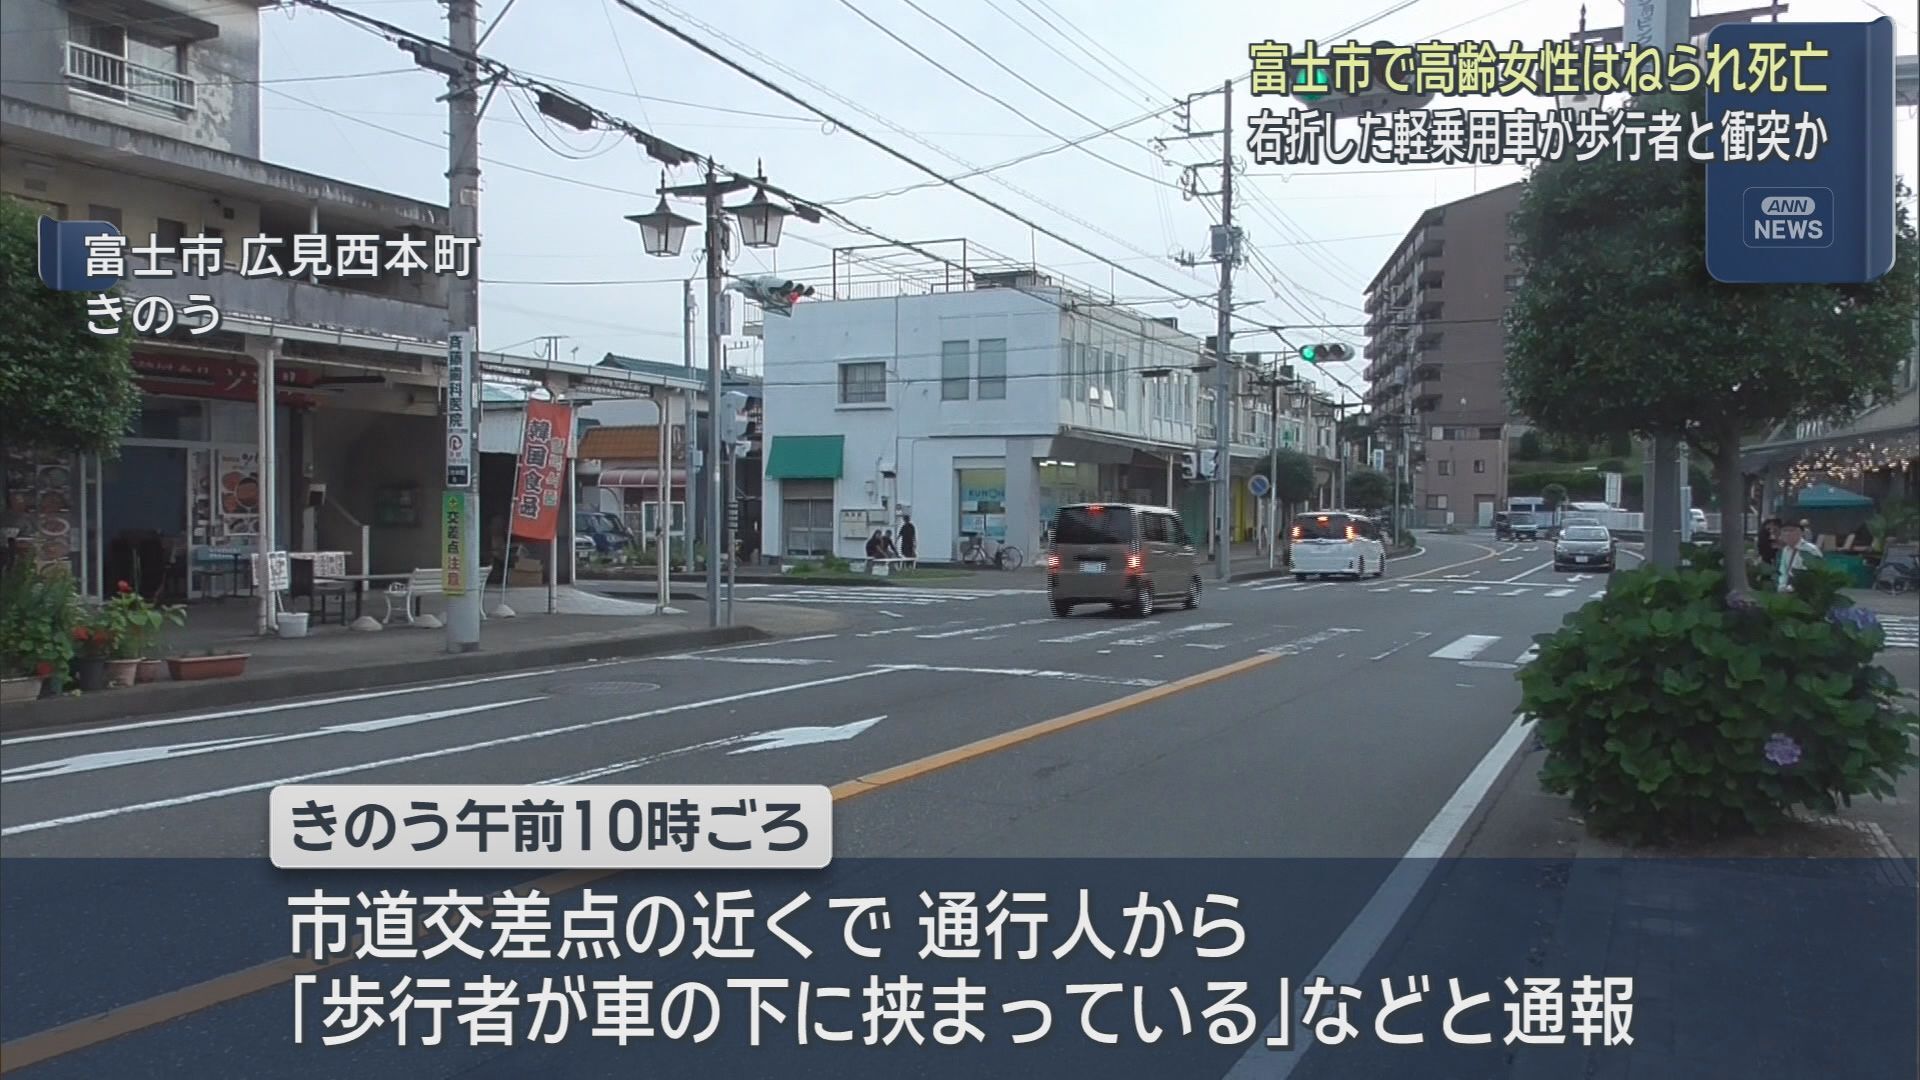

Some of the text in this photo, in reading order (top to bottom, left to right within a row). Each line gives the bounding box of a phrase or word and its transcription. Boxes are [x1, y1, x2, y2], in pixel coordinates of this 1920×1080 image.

[519, 418, 552, 520] 韓国食品
[446, 511, 461, 588] 交差点注意
